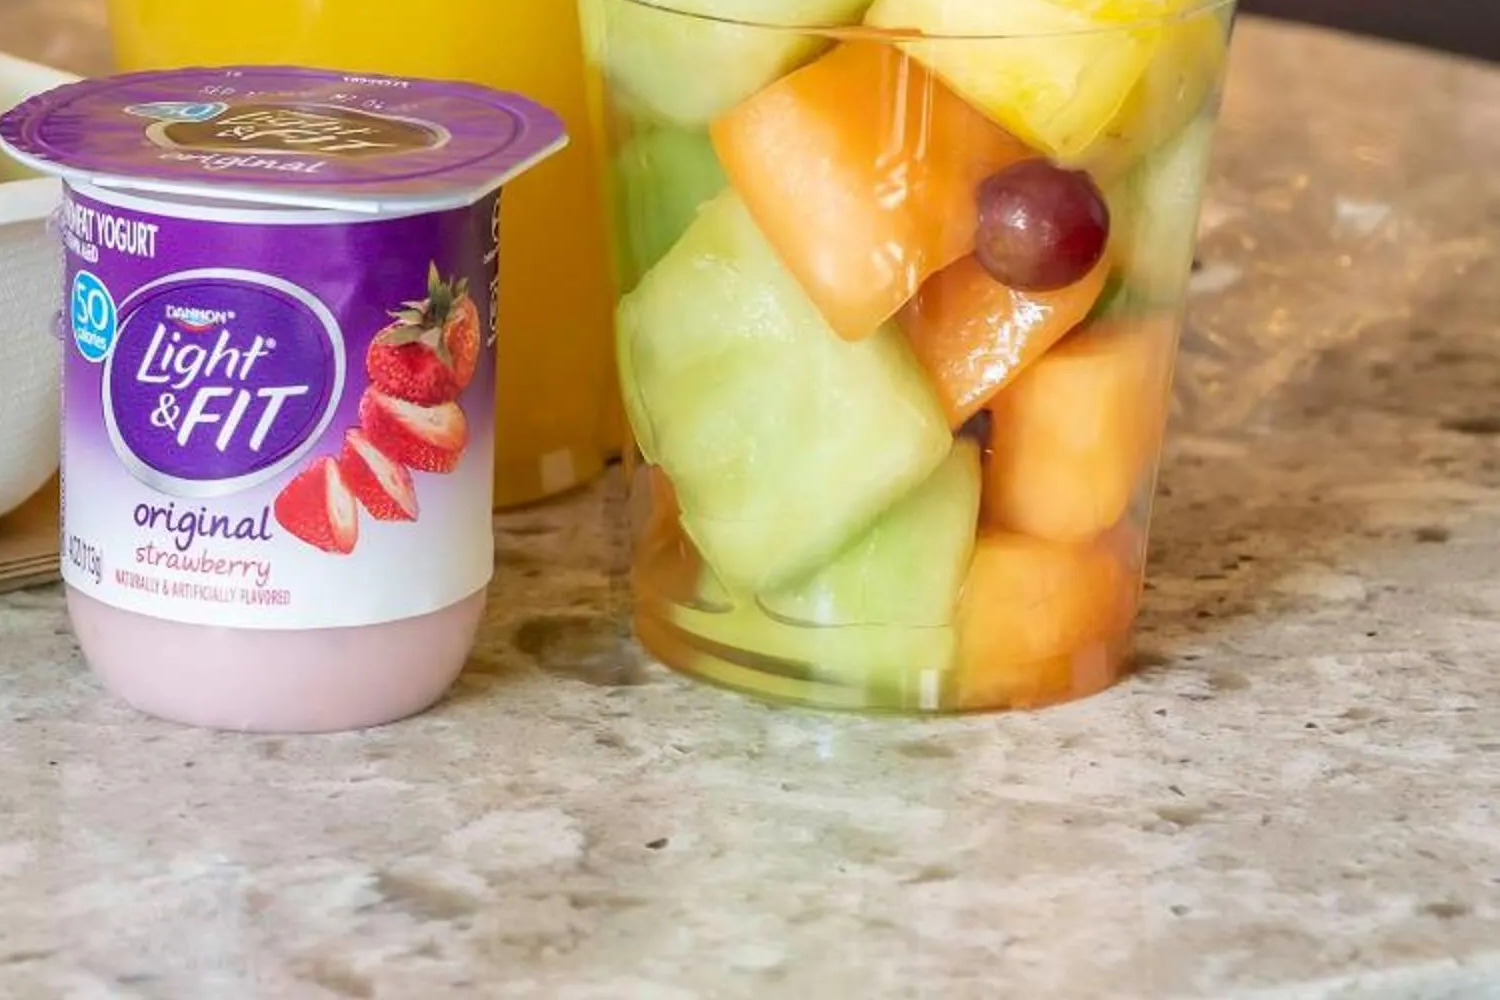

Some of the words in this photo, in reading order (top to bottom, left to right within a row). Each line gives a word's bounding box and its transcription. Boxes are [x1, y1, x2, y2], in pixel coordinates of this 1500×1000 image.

[158, 152, 328, 173] original
[95, 211, 160, 259] YOGURT
[76, 282, 109, 331] 50
[136, 322, 269, 390] Light
[151, 392, 181, 432] &
[176, 385, 309, 452] FIT
[133, 501, 274, 552] original
[115, 568, 159, 596] NATURALLY
[171, 580, 236, 603] ARTIFICIALLY
[240, 587, 291, 606] FLAVORED
[135, 541, 271, 587] strawberry
